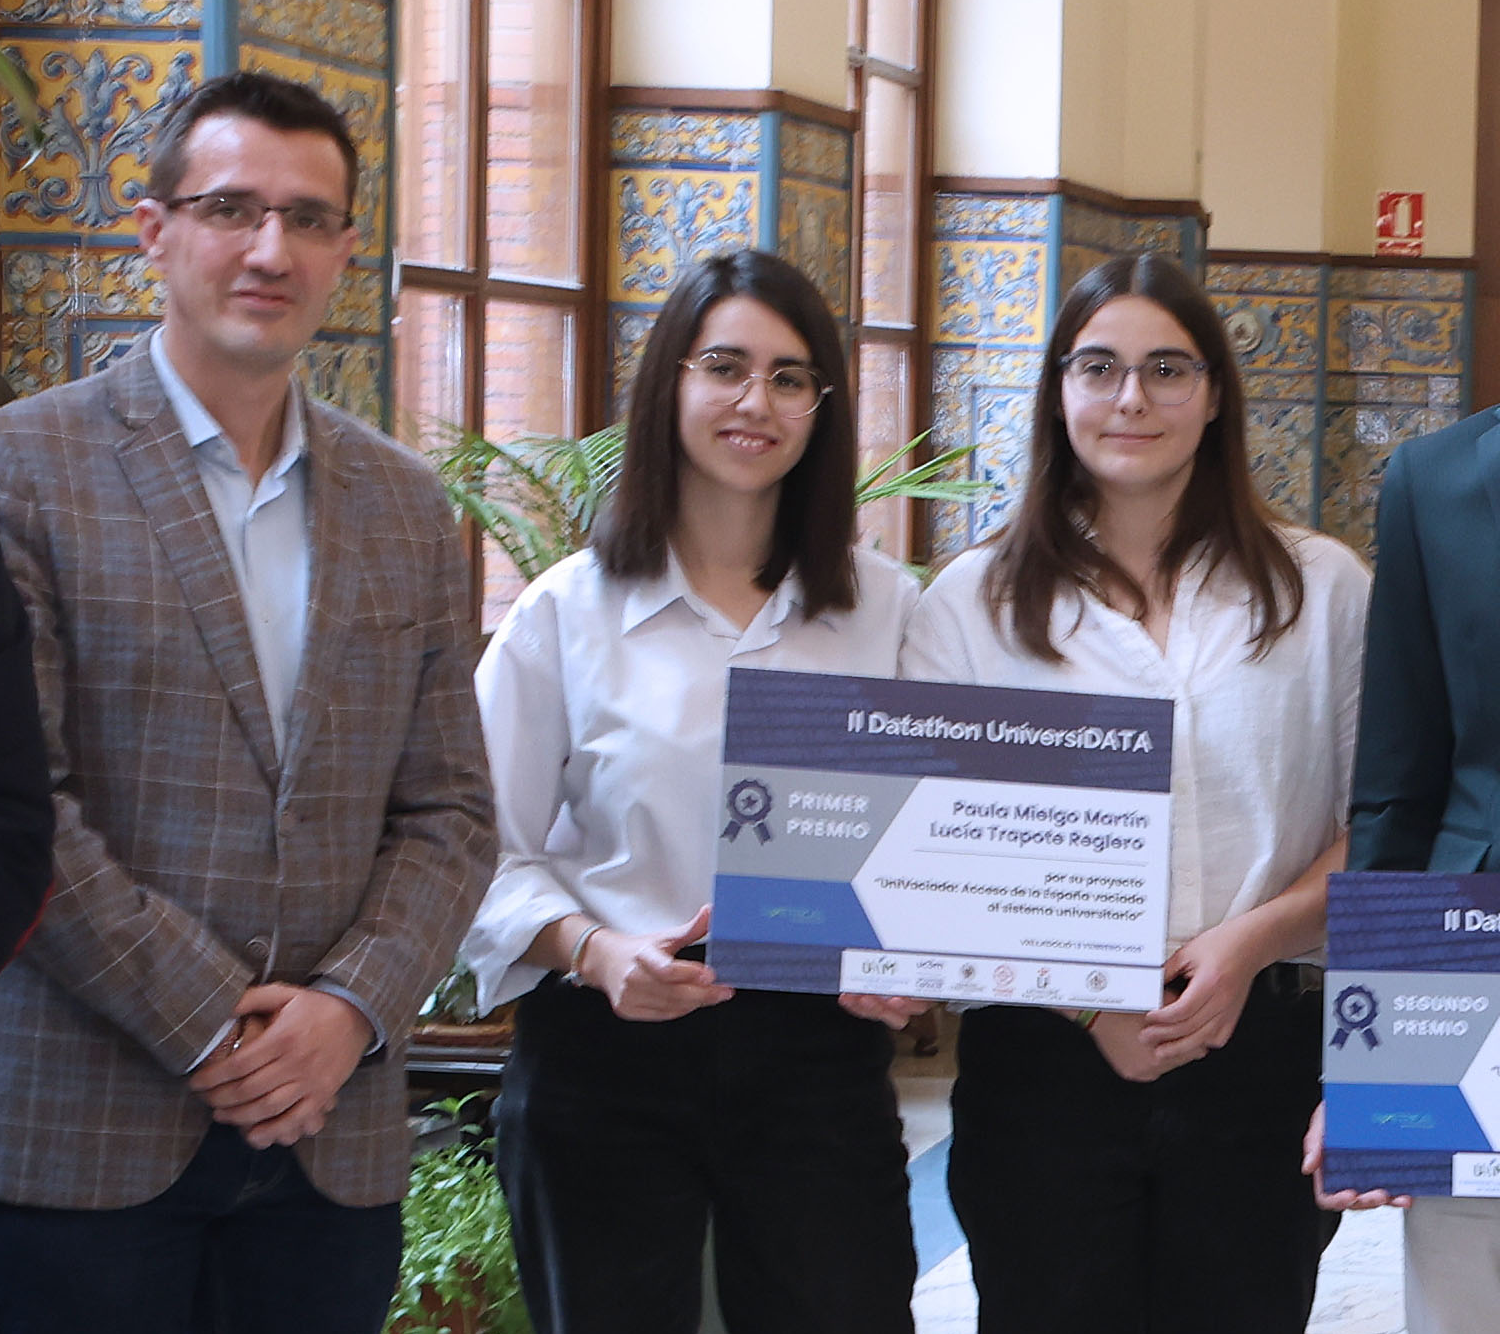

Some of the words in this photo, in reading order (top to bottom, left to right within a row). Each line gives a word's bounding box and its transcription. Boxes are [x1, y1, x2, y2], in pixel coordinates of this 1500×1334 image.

[847, 709, 865, 733] II
[868, 710, 982, 741] Datathon
[986, 719, 1154, 754] UniversiDATA
[788, 791, 869, 813] PRIMER
[952, 800, 1008, 819] Paula
[1013, 803, 1080, 828] Mielgo
[1083, 808, 1150, 829] Martín
[786, 818, 870, 839] PREMIO
[930, 821, 982, 840] Lucía
[987, 824, 1064, 847] Trapote
[1069, 831, 1145, 853] Reglero
[1044, 872, 1066, 885] por
[1068, 875, 1083, 884] su
[1086, 875, 1145, 890] proyecto
[961, 883, 1008, 896] Acceso
[1010, 885, 1026, 897] de
[1028, 887, 1041, 898] la
[1043, 886, 1089, 902] España
[1092, 890, 1146, 905] vaciada
[987, 901, 1000, 913] al
[1002, 903, 1054, 917] sistema
[1444, 908, 1460, 932] II
[1393, 995, 1490, 1012] SEGUNDO
[1392, 1019, 1469, 1036] PREMIO
